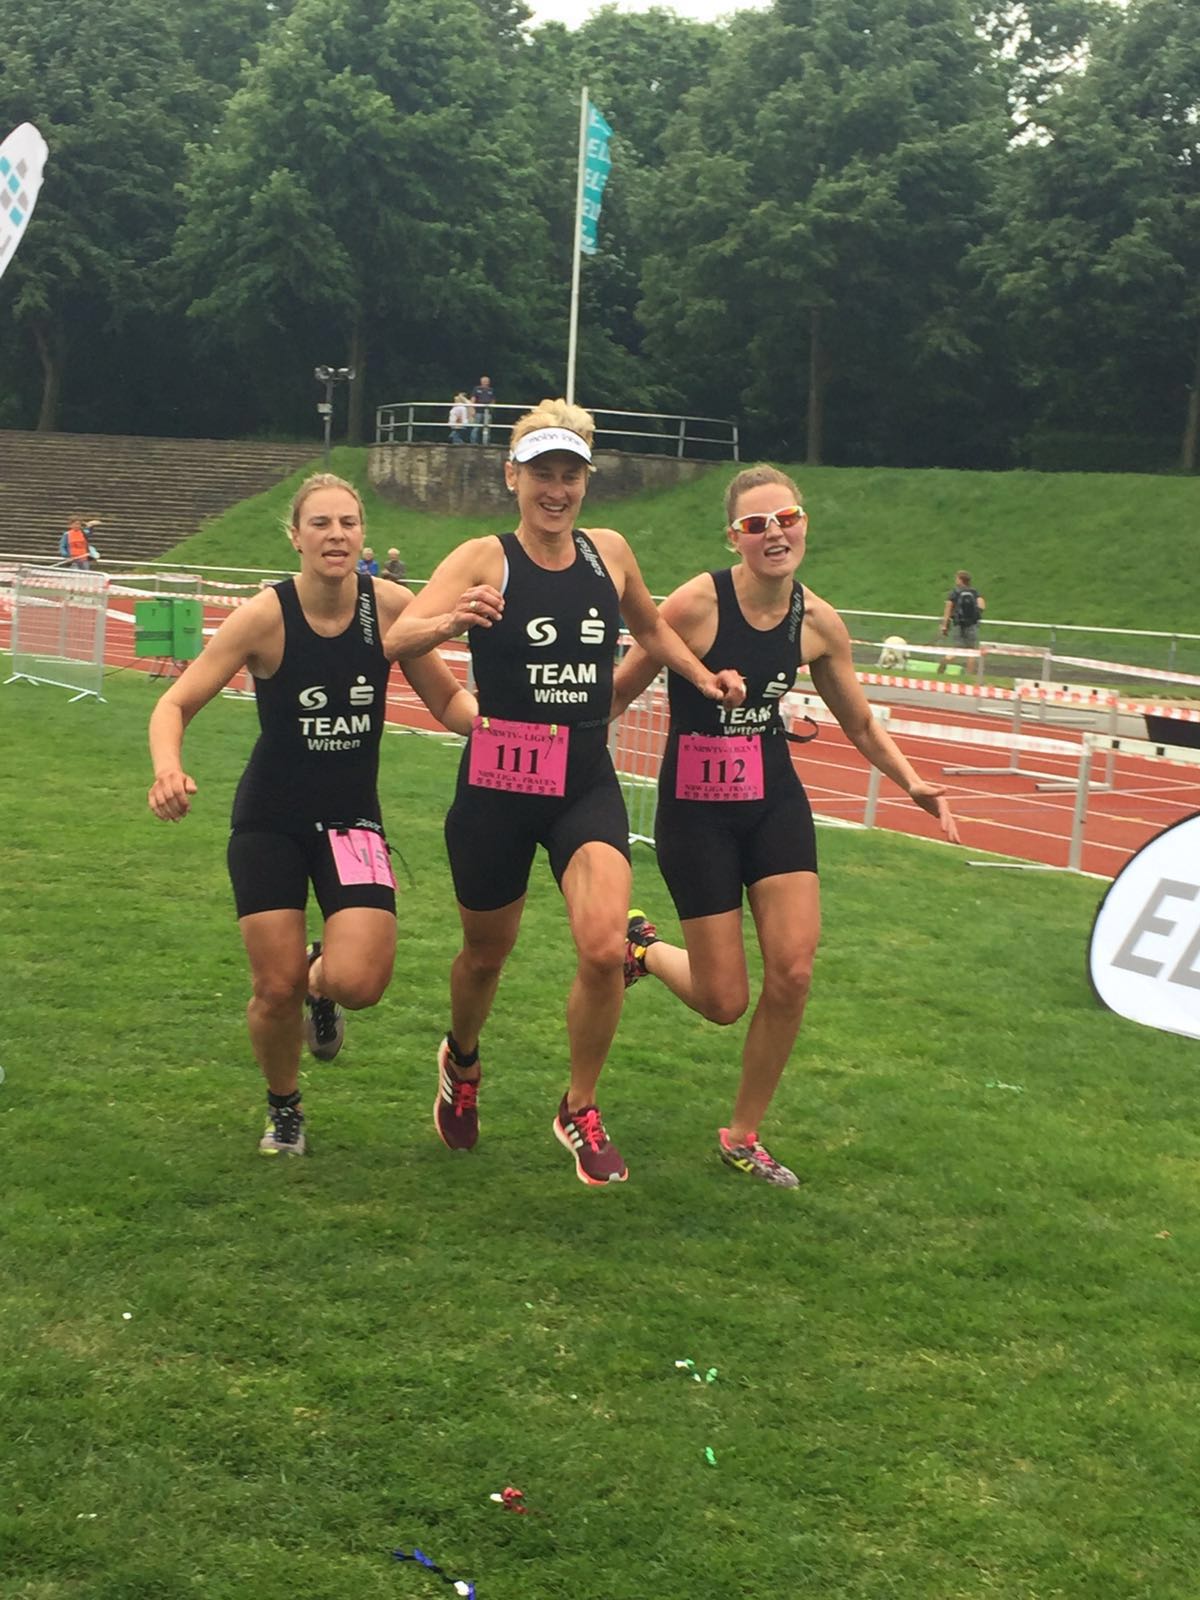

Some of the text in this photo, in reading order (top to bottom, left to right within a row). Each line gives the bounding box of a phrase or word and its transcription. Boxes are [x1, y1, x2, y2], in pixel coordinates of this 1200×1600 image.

[359, 592, 375, 646] sailfish
[526, 663, 597, 684] TEAM
[534, 688, 589, 704] Witten
[717, 704, 772, 724] TEAM
[299, 714, 371, 736] TEAM
[307, 738, 361, 751] Witten
[496, 744, 539, 774] 111
[701, 759, 745, 783] 112
